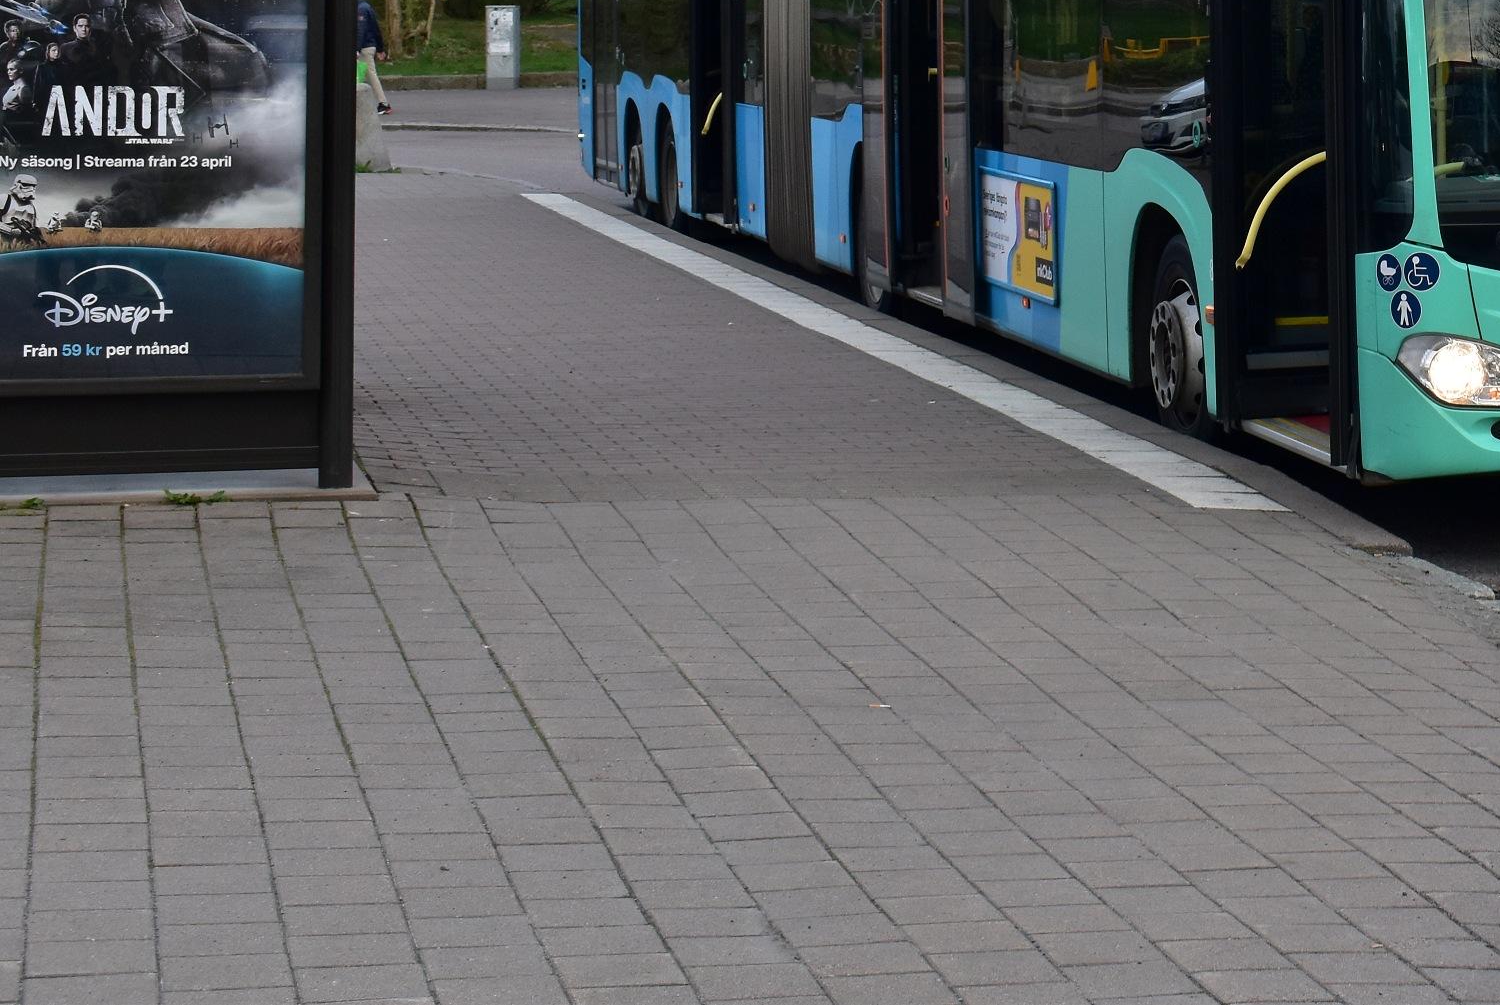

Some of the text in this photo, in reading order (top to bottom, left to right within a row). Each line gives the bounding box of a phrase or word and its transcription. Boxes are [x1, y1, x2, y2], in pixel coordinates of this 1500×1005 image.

[42, 85, 185, 137] ANDOR
[0, 156, 17, 170] Ny
[21, 154, 73, 170] säsong
[84, 155, 145, 168] Streama
[148, 154, 177, 168] från
[180, 155, 198, 168] 23
[201, 154, 232, 170] april
[38, 290, 174, 335] Disney+
[23, 342, 189, 359] Från 59 kr per månad
